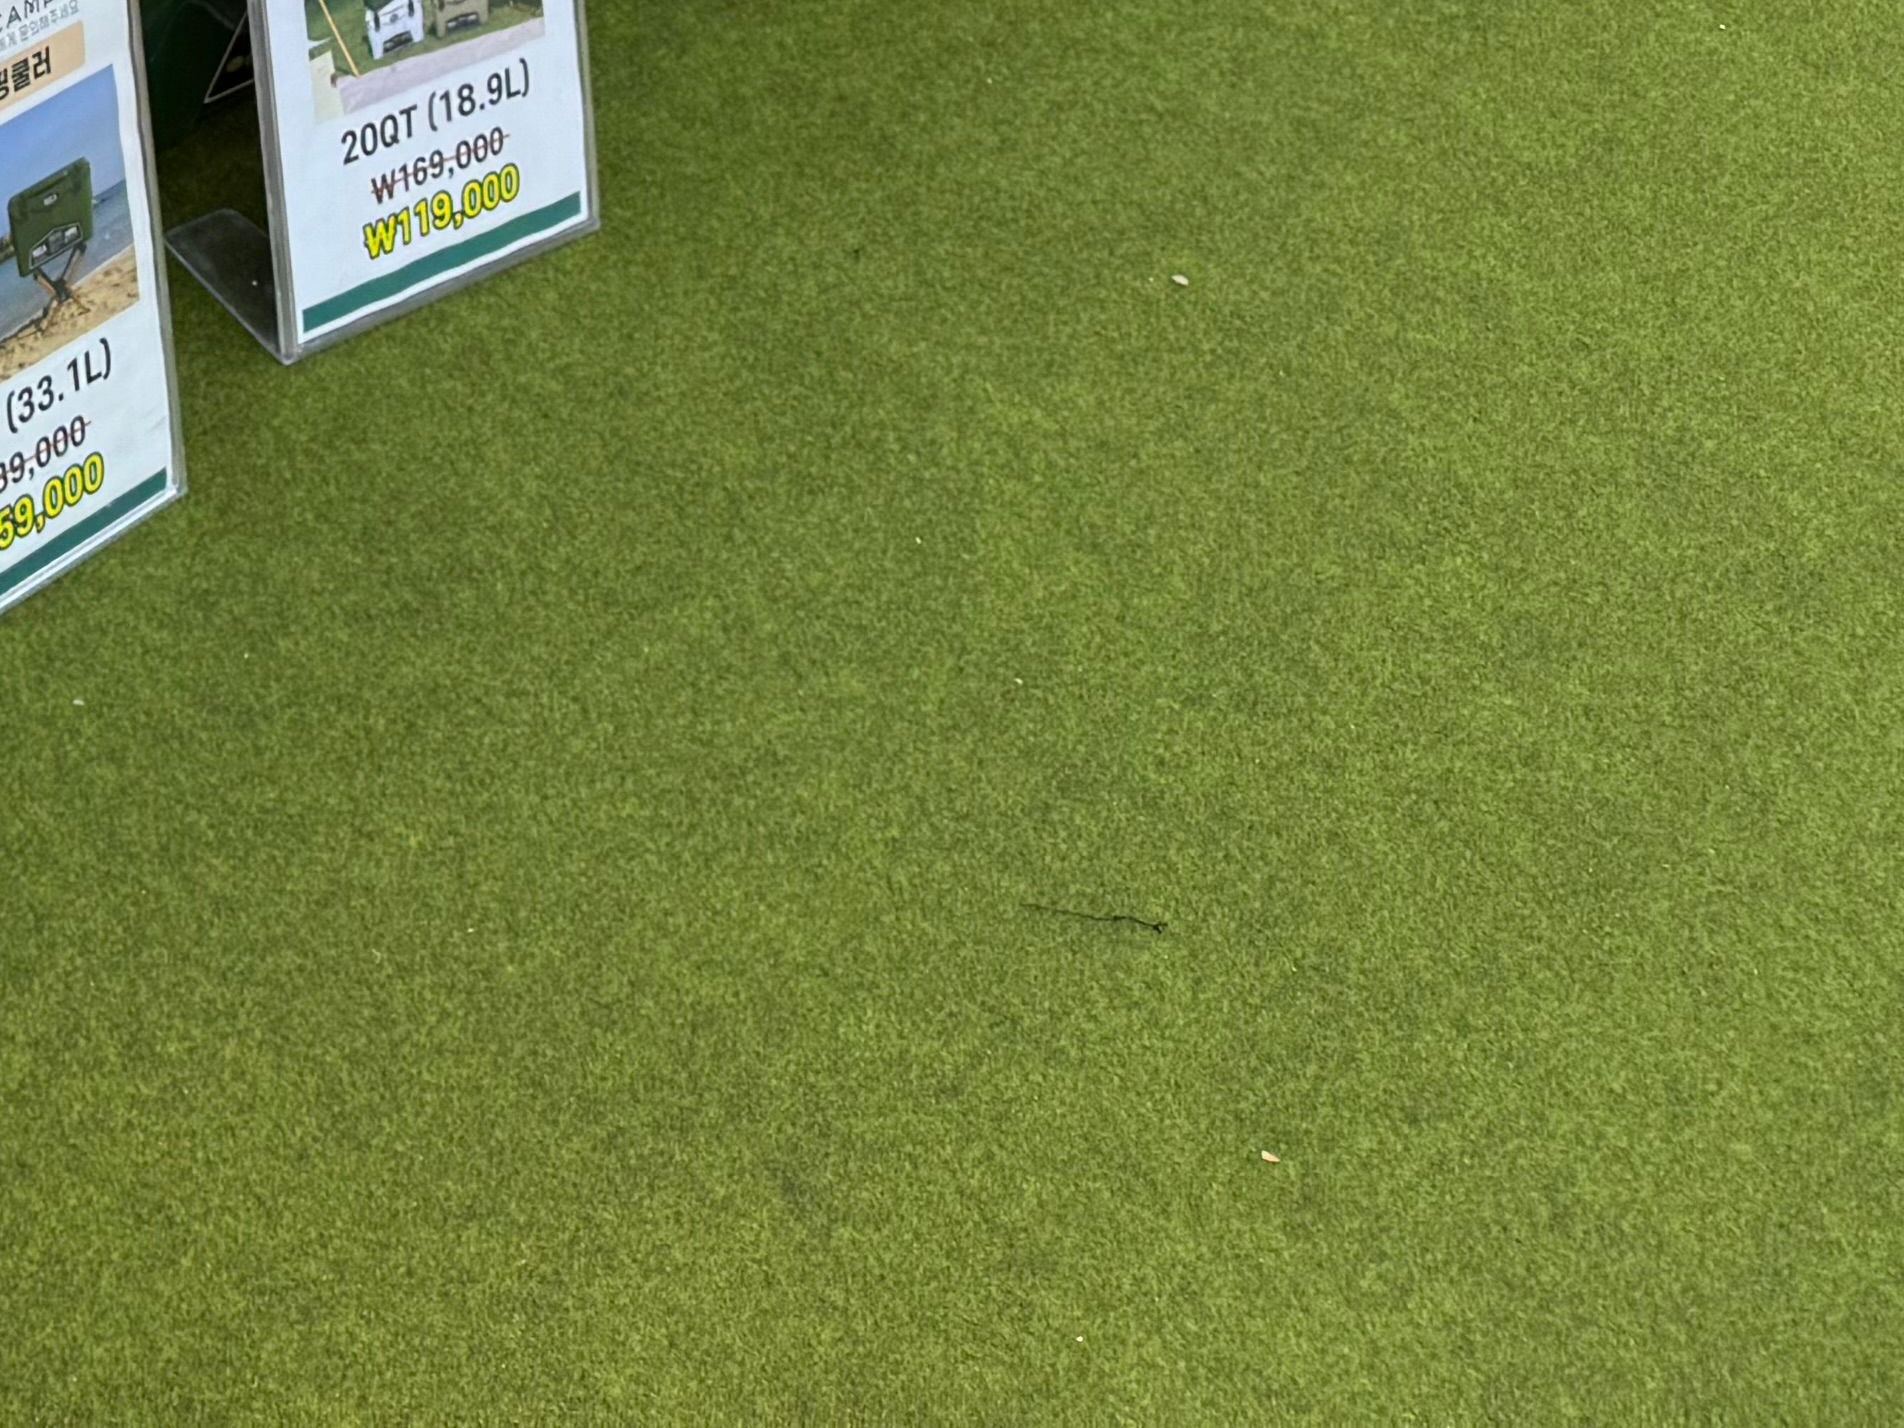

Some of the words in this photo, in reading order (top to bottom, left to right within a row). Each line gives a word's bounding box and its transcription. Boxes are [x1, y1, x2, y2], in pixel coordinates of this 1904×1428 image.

[341, 104, 418, 165] 20QT
[428, 57, 530, 132] (18.9L)
[6, 337, 112, 435] (33.1L)
